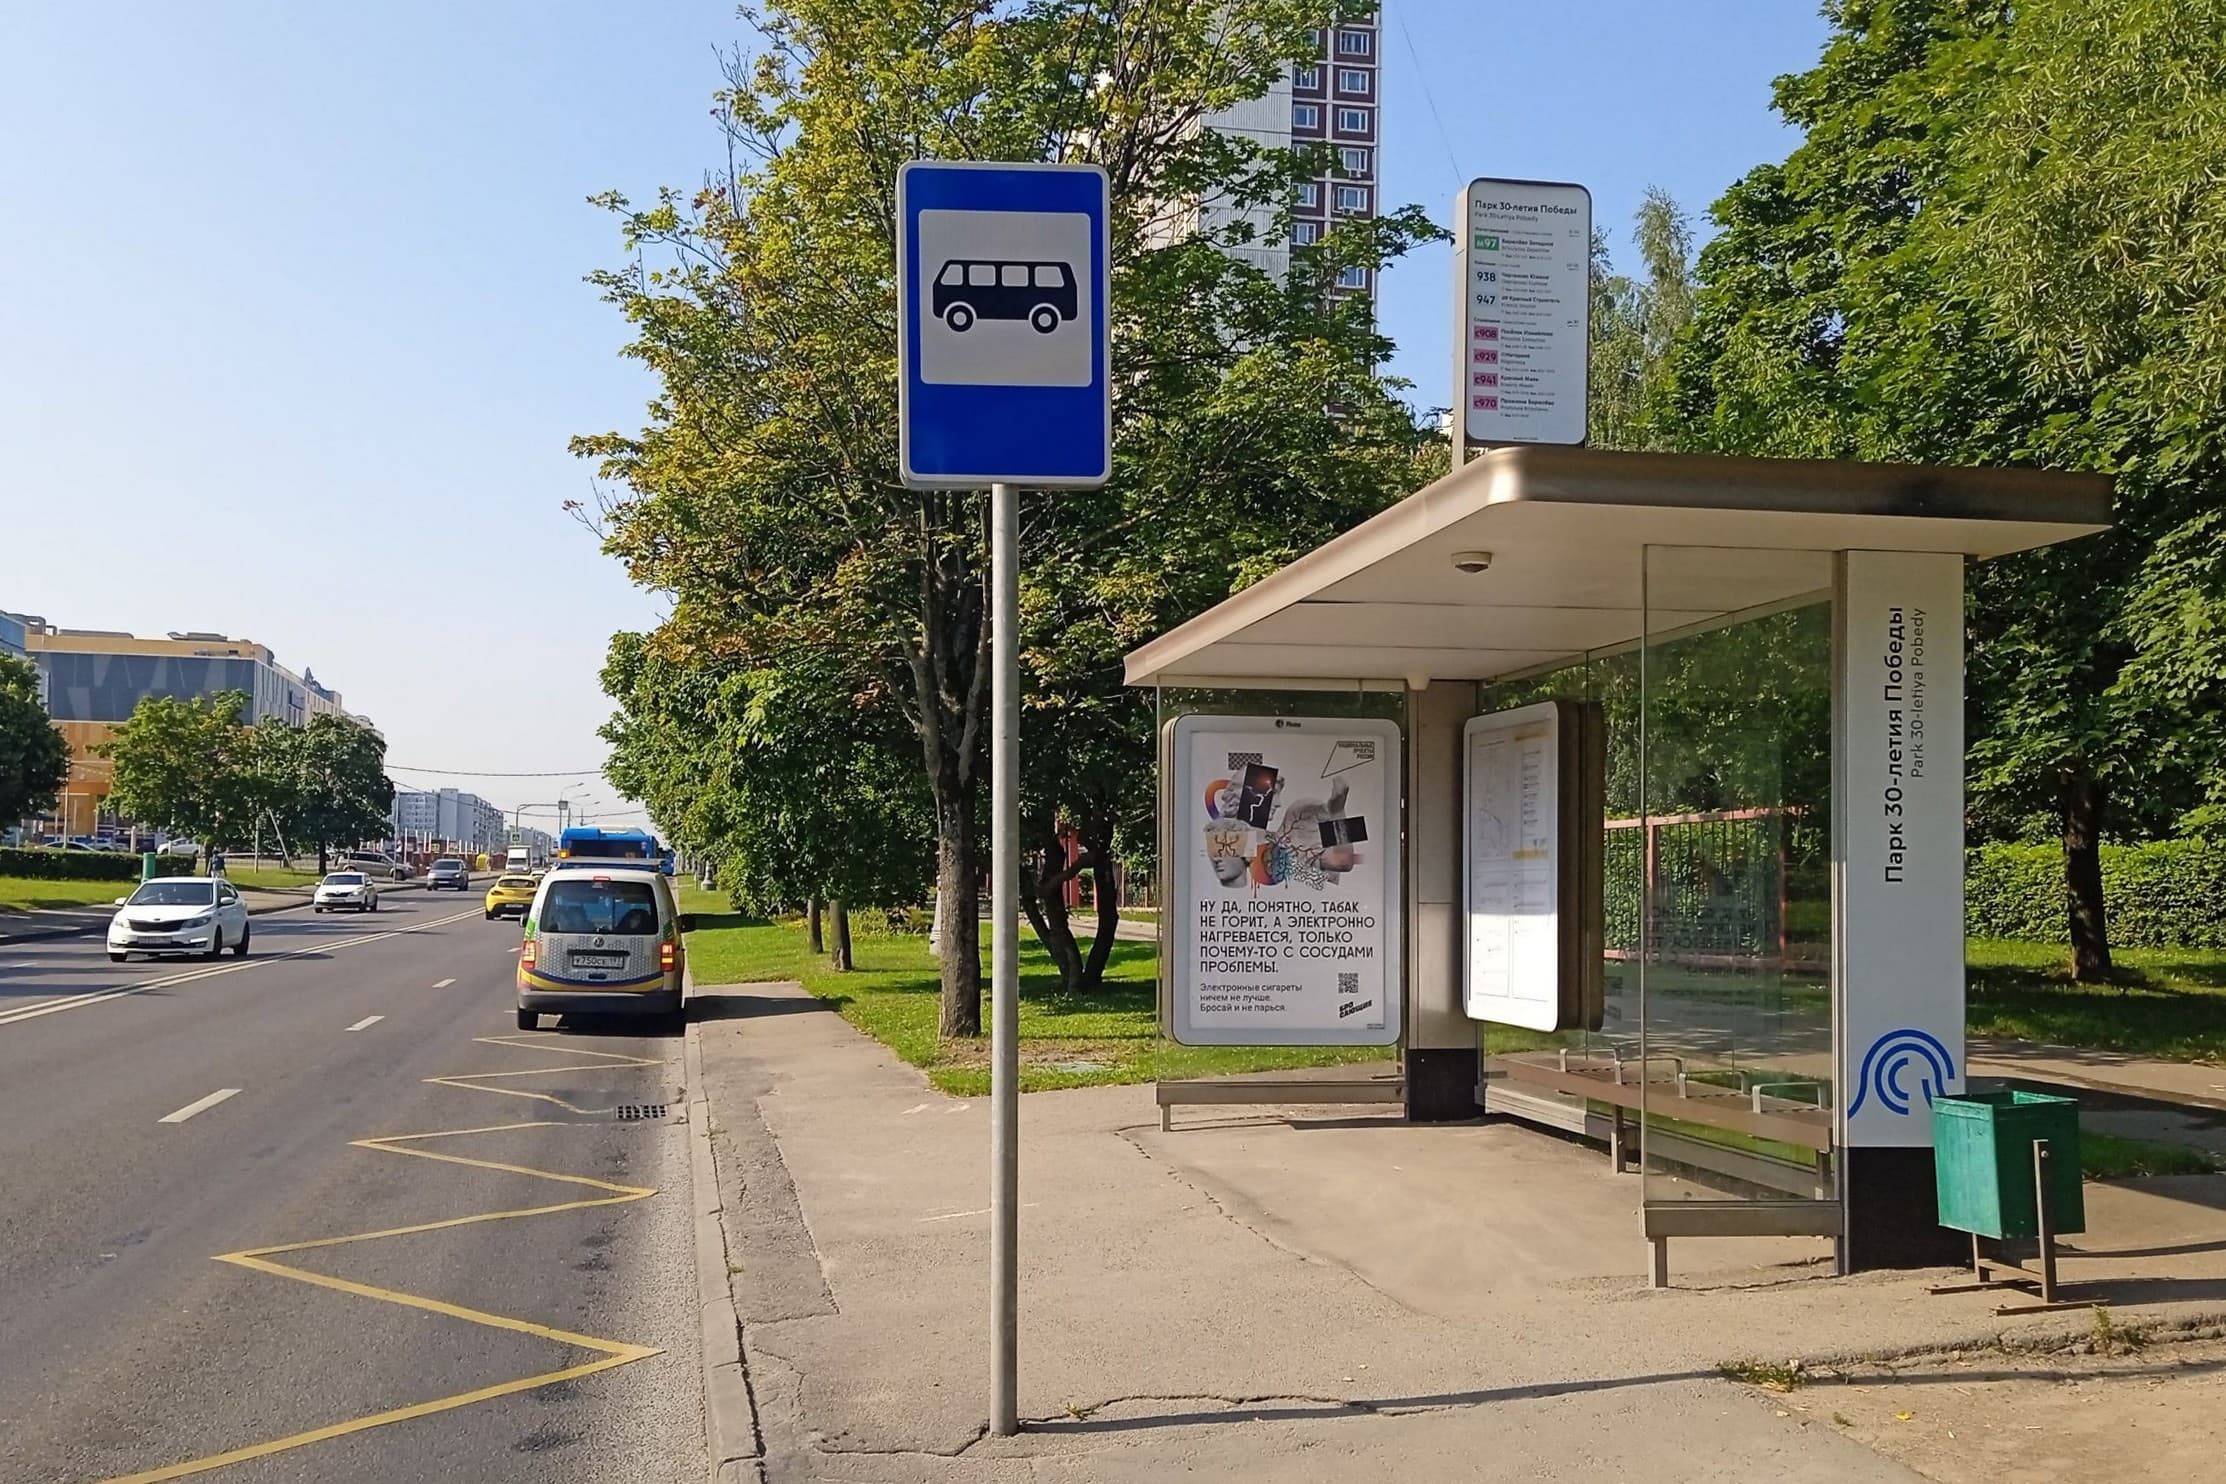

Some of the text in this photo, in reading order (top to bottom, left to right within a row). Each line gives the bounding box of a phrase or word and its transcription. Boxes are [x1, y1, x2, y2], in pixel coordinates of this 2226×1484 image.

[1475, 200, 1577, 215] Парк 30-летия Победы
[1476, 271, 1497, 282] 938
[1476, 294, 1496, 305] 947
[1910, 608, 1927, 778] Park 30-letiya Pobedy
[1884, 607, 1907, 883] Парк 30-летия Победы
[1200, 901, 1216, 913] НУ
[1221, 901, 1242, 915] ДА,
[1248, 901, 1316, 914] ПОНЯТНО,
[1200, 916, 1375, 929] НЕ ГОРИТ, А ЭЛЕКТРОННО
[1200, 931, 1353, 944] НАГРЕВАЕТСЯ, ТОЛЬКО
[1200, 946, 1373, 960] ПОЧЕМУ-ТО С СОСУДАМИ
[1200, 983, 1303, 993] Электронные сигареты
[1200, 1003, 1233, 1013] Бросай
